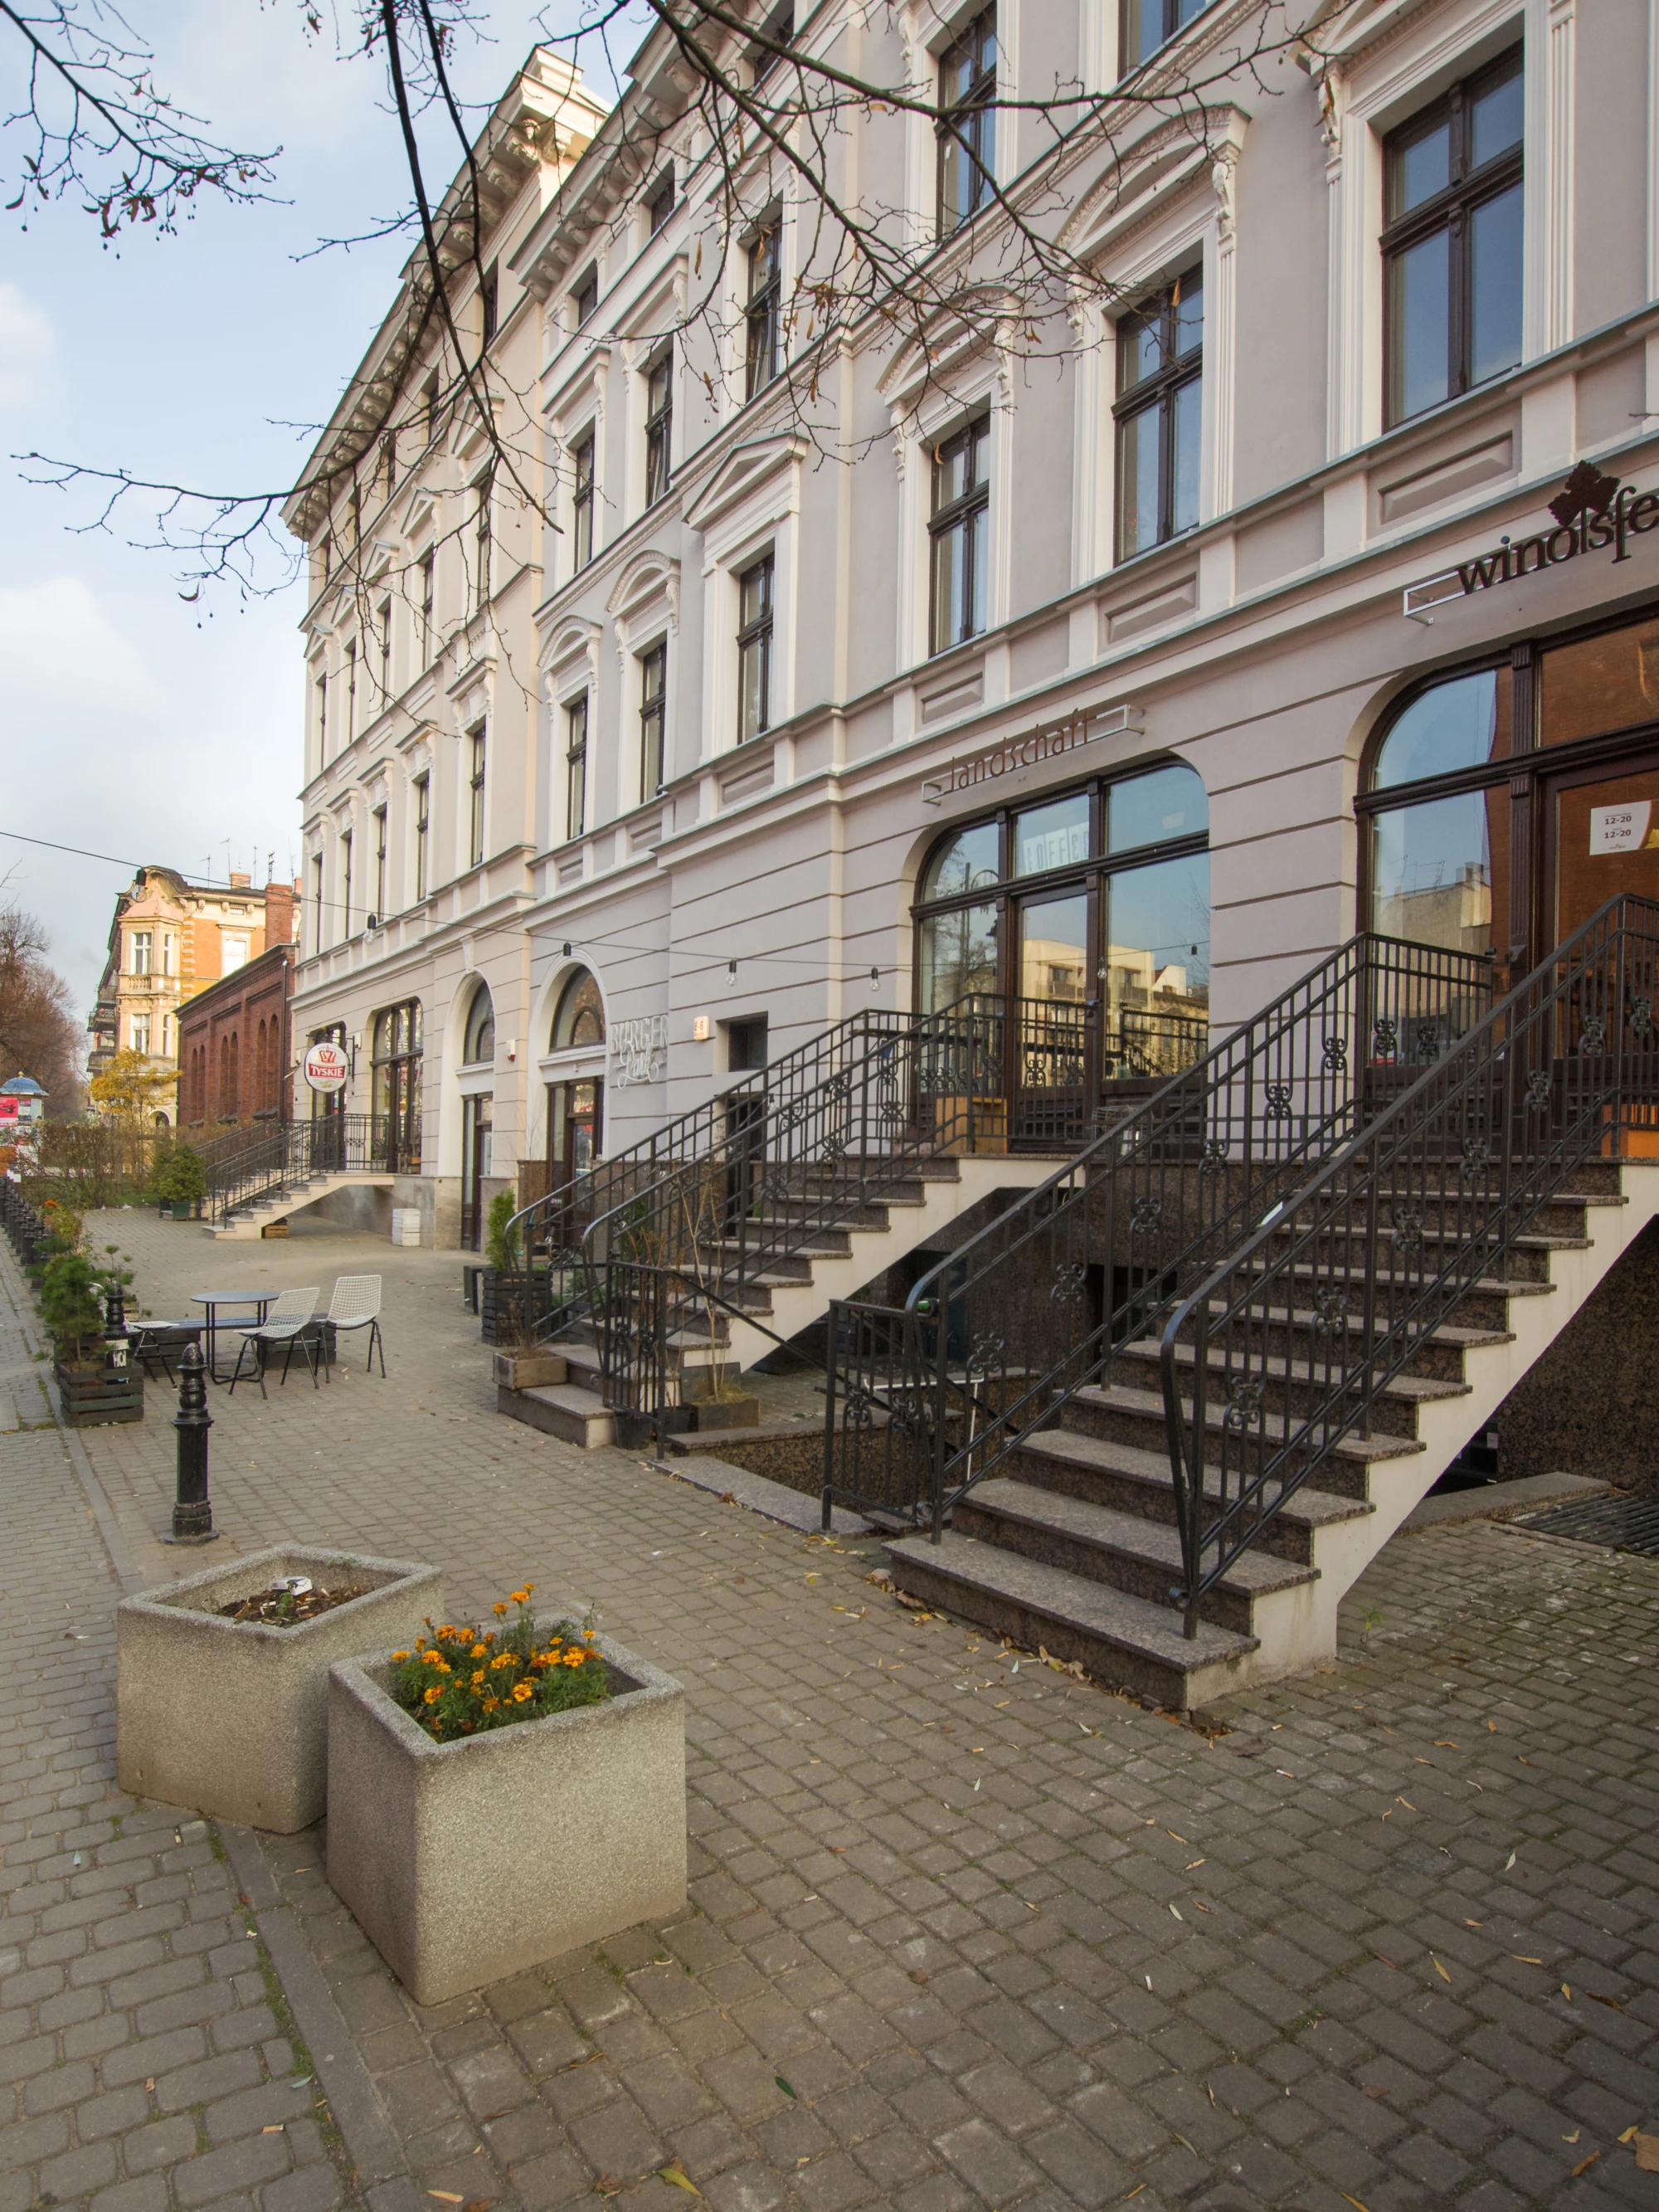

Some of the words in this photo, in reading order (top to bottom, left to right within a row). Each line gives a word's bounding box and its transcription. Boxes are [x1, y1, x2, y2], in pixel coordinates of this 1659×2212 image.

[944, 708, 1097, 792] landschaft
[1604, 815, 1632, 825] 12-20
[1604, 829, 1631, 839] 12-20
[611, 1014, 668, 1054] BURGER
[311, 1065, 343, 1077] TYSKIE
